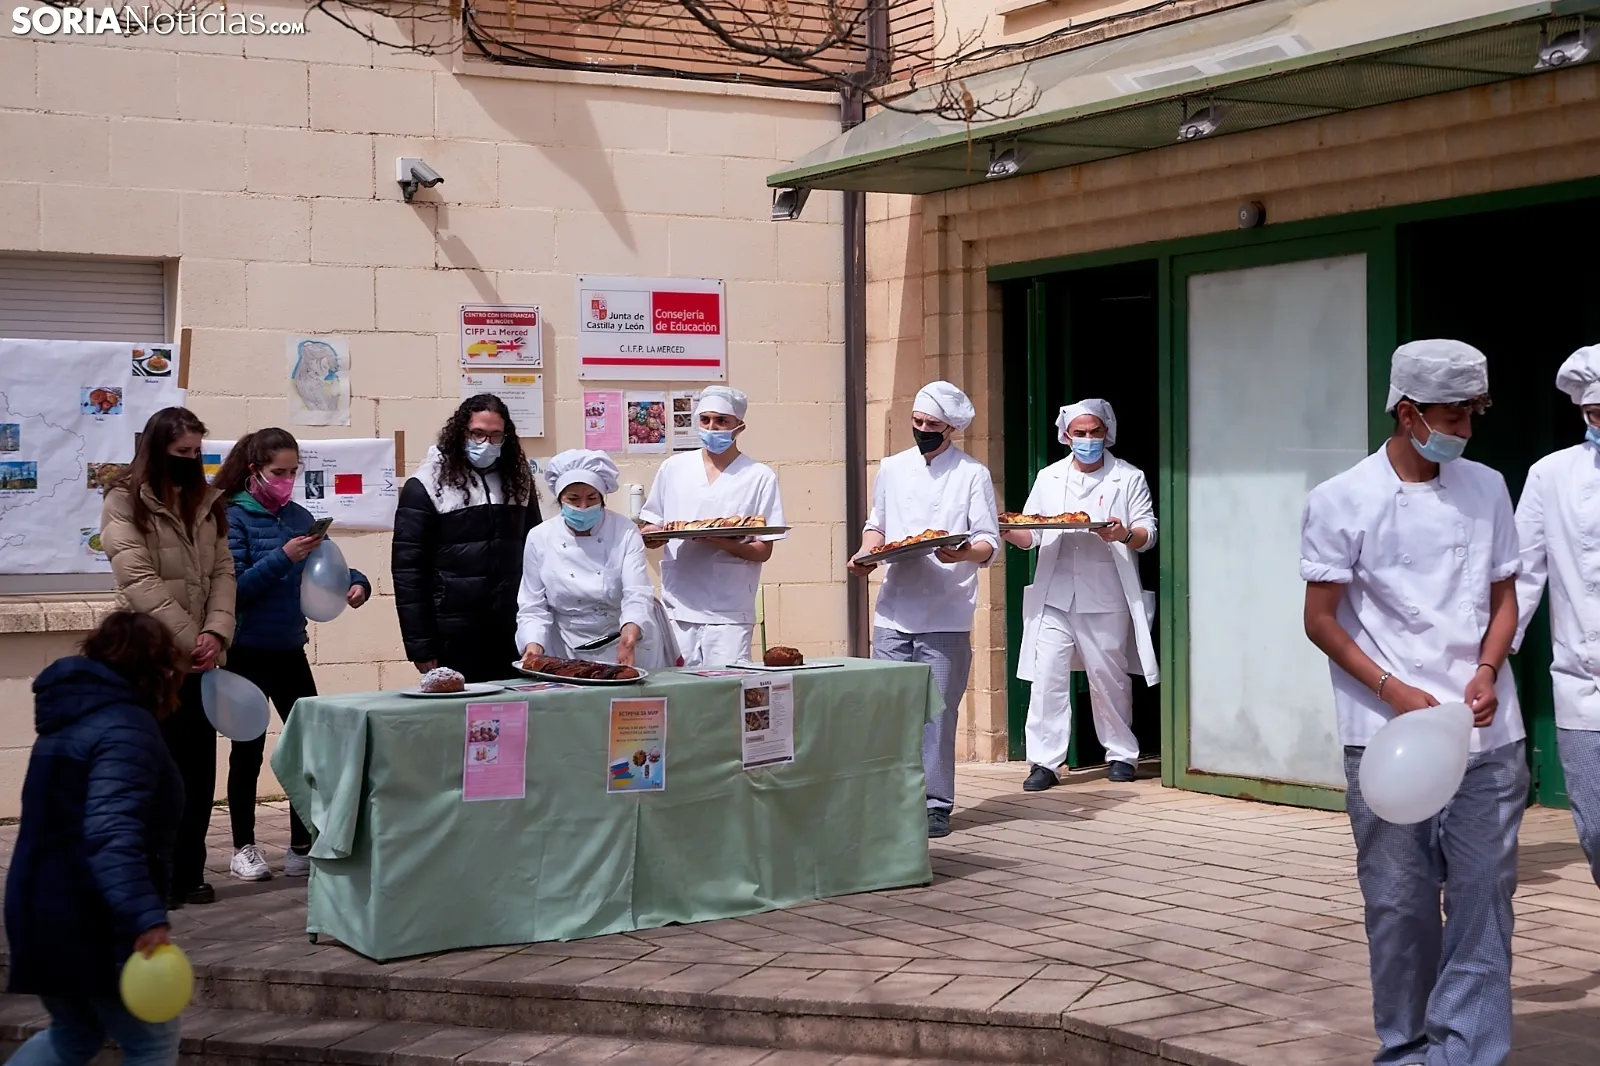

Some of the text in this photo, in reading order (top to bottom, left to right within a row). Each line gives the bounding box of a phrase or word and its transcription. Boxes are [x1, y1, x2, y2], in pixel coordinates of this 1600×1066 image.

[609, 312, 631, 320] Junta
[655, 308, 704, 321] Consejería
[587, 321, 644, 331] Castilla y León
[655, 321, 717, 332] de Educación
[620, 345, 644, 353] C.I.F.P.
[656, 346, 685, 354] MERCED
